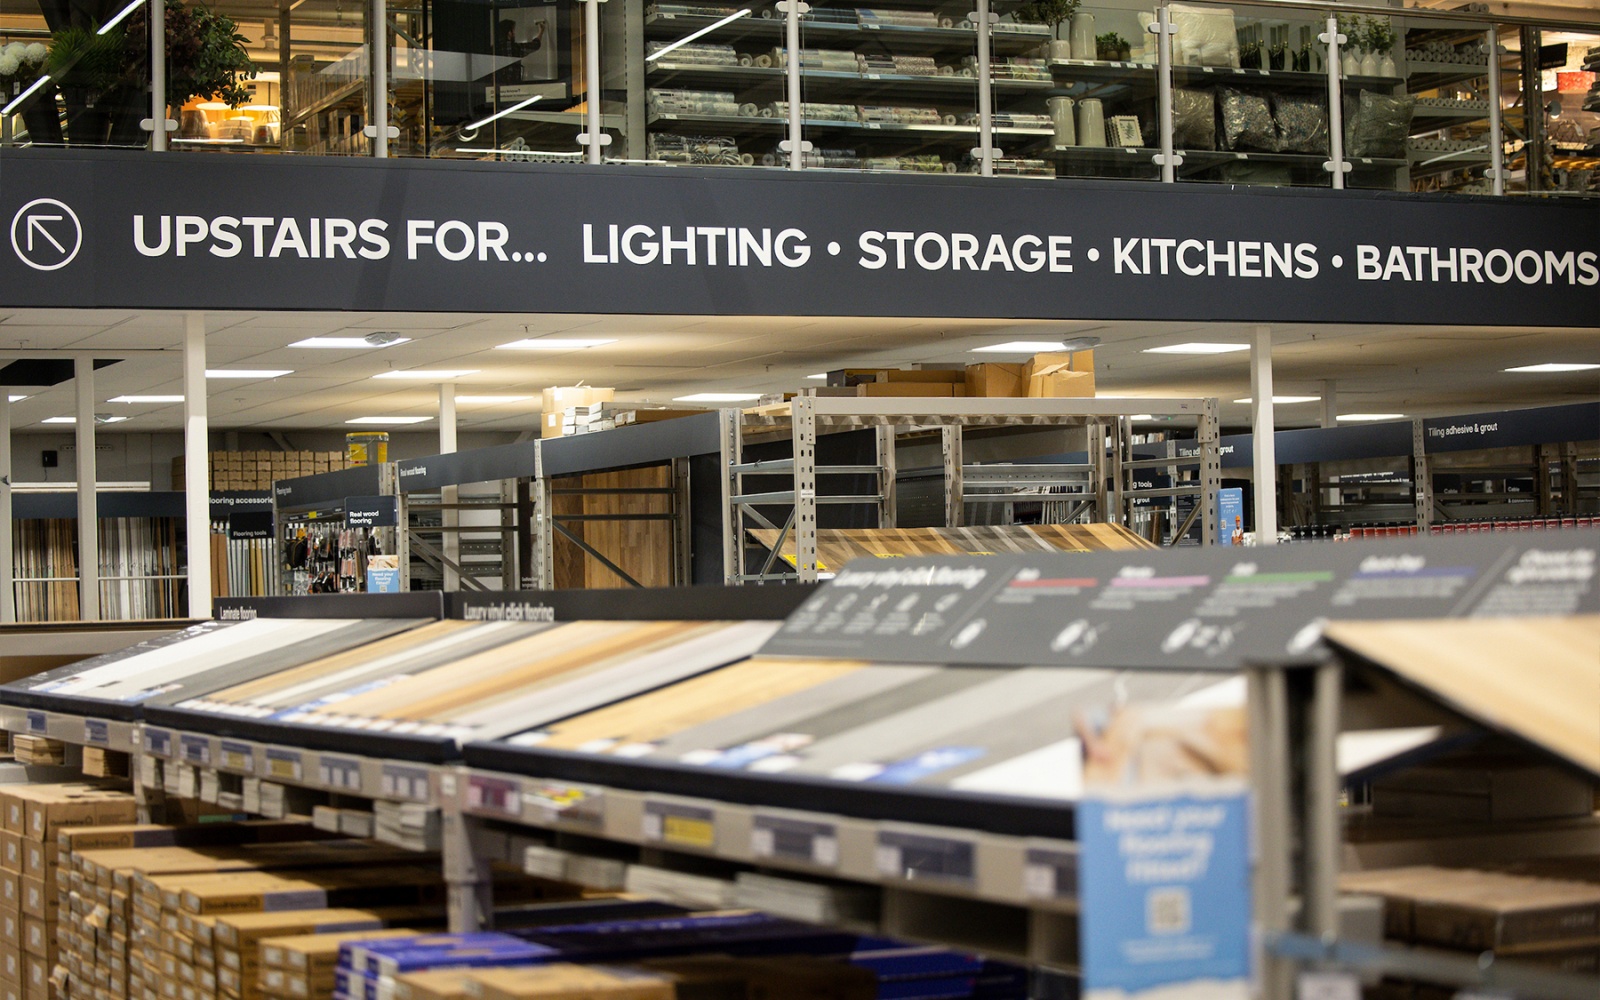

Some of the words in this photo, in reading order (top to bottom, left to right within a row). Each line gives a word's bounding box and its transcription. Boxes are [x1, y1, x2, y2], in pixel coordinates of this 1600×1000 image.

[133, 214, 391, 260] UPSTAIRS
[406, 219, 548, 263] FOR...
[582, 223, 812, 268] LIGHTING
[858, 230, 1073, 275] STORAGE
[1113, 237, 1319, 280] KITCHENS
[1356, 244, 1600, 286] BATHROOMS
[1428, 427, 1445, 438] Tiling
[1445, 425, 1473, 435] adhesive
[1474, 423, 1479, 433] &
[1480, 423, 1498, 434] grout
[209, 496, 234, 505] looring
[235, 496, 273, 504] accessorie
[350, 517, 372, 525] flooring
